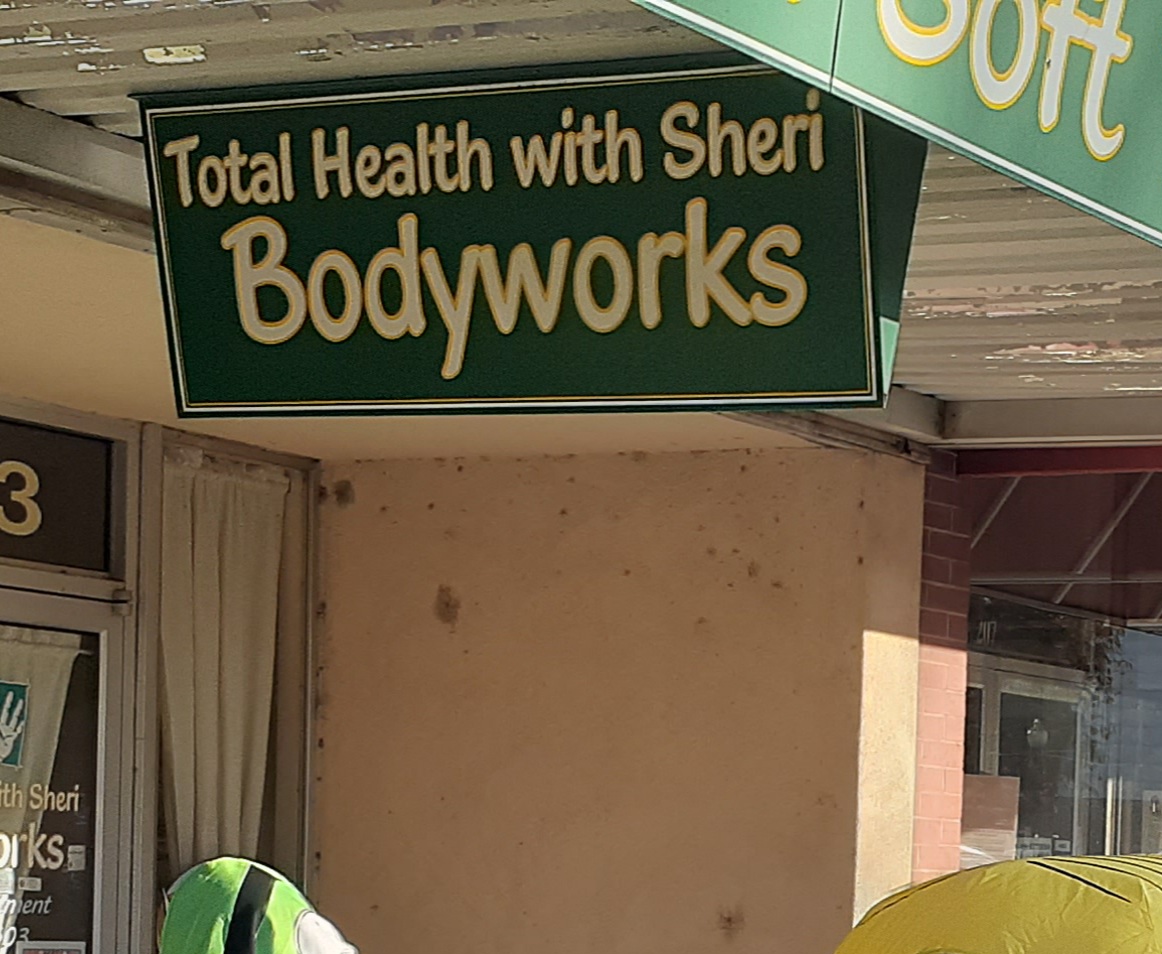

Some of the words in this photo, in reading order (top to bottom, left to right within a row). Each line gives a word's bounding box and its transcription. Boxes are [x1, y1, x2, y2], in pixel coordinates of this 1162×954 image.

[164, 131, 294, 208] Total
[313, 119, 492, 200] Health
[510, 107, 643, 188] with
[661, 88, 824, 181] Sheri
[220, 197, 807, 380] Bodyworks
[0, 460, 43, 536] 3
[30, 783, 79, 812] Sheri
